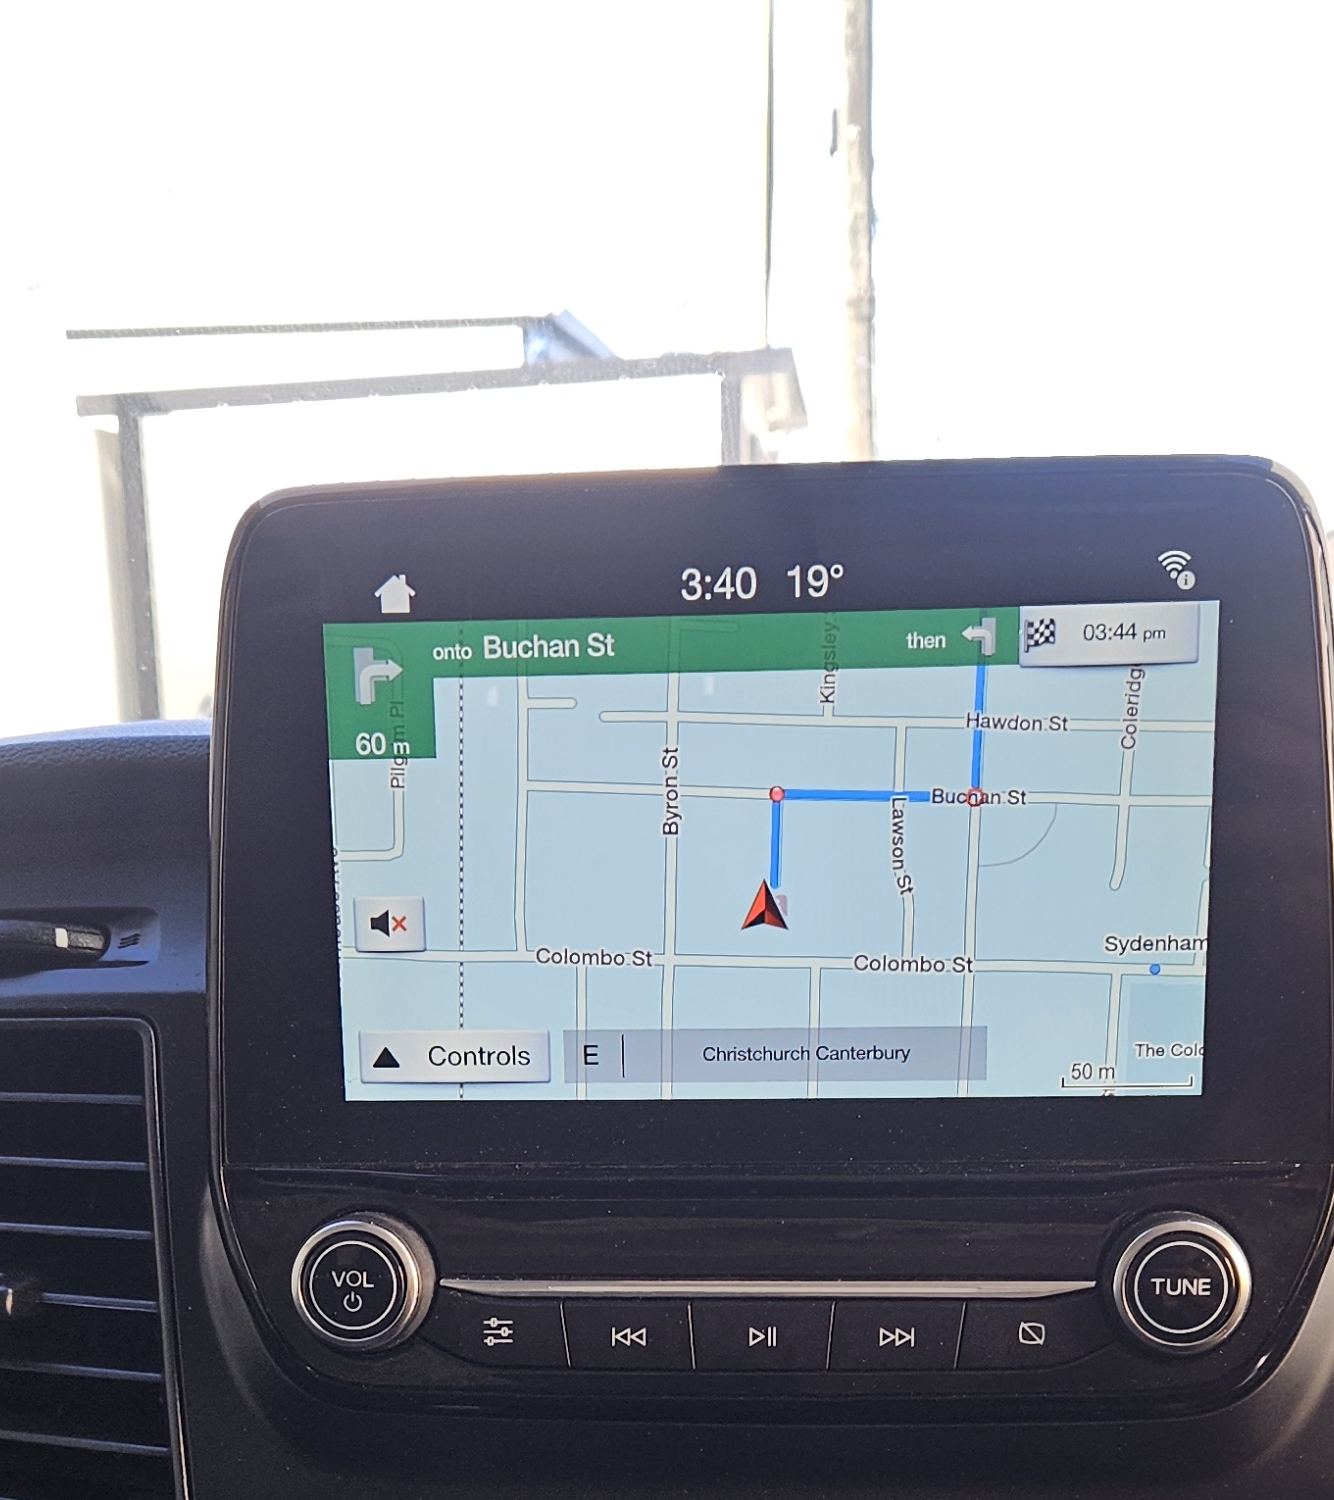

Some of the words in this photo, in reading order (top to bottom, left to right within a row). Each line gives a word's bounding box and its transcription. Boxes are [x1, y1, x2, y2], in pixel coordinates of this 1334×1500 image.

[681, 566, 757, 601] 3:40
[906, 631, 946, 650] then
[1082, 622, 1137, 642] 03:44
[1143, 627, 1167, 643] pm
[432, 643, 472, 661] onto
[483, 634, 580, 660] Buchan
[587, 632, 616, 658] St
[1121, 664, 1146, 750] Coleridg
[966, 712, 1043, 732] Hawdon
[1049, 714, 1069, 732] St
[355, 732, 386, 756] 60
[393, 742, 410, 755] m
[662, 746, 679, 769] St
[662, 775, 682, 837] Byron
[931, 788, 1001, 805] Buchan
[1007, 789, 1027, 805] St
[892, 797, 907, 871] Lawson
[896, 874, 914, 896] St
[1104, 935, 1208, 956] Sydenham
[535, 947, 625, 967] Colombo
[632, 949, 653, 968] St
[853, 954, 946, 973] Colombo
[952, 956, 974, 974] St
[427, 1044, 531, 1068] Controls
[583, 1044, 599, 1066] E
[703, 1045, 810, 1063] Christchurch
[816, 1045, 912, 1063] Canterbury
[1135, 1043, 1165, 1058] The
[1071, 1062, 1093, 1080] 50
[1099, 1066, 1115, 1080] m
[331, 1270, 375, 1289] VOL
[1150, 1278, 1212, 1297] TUNE
